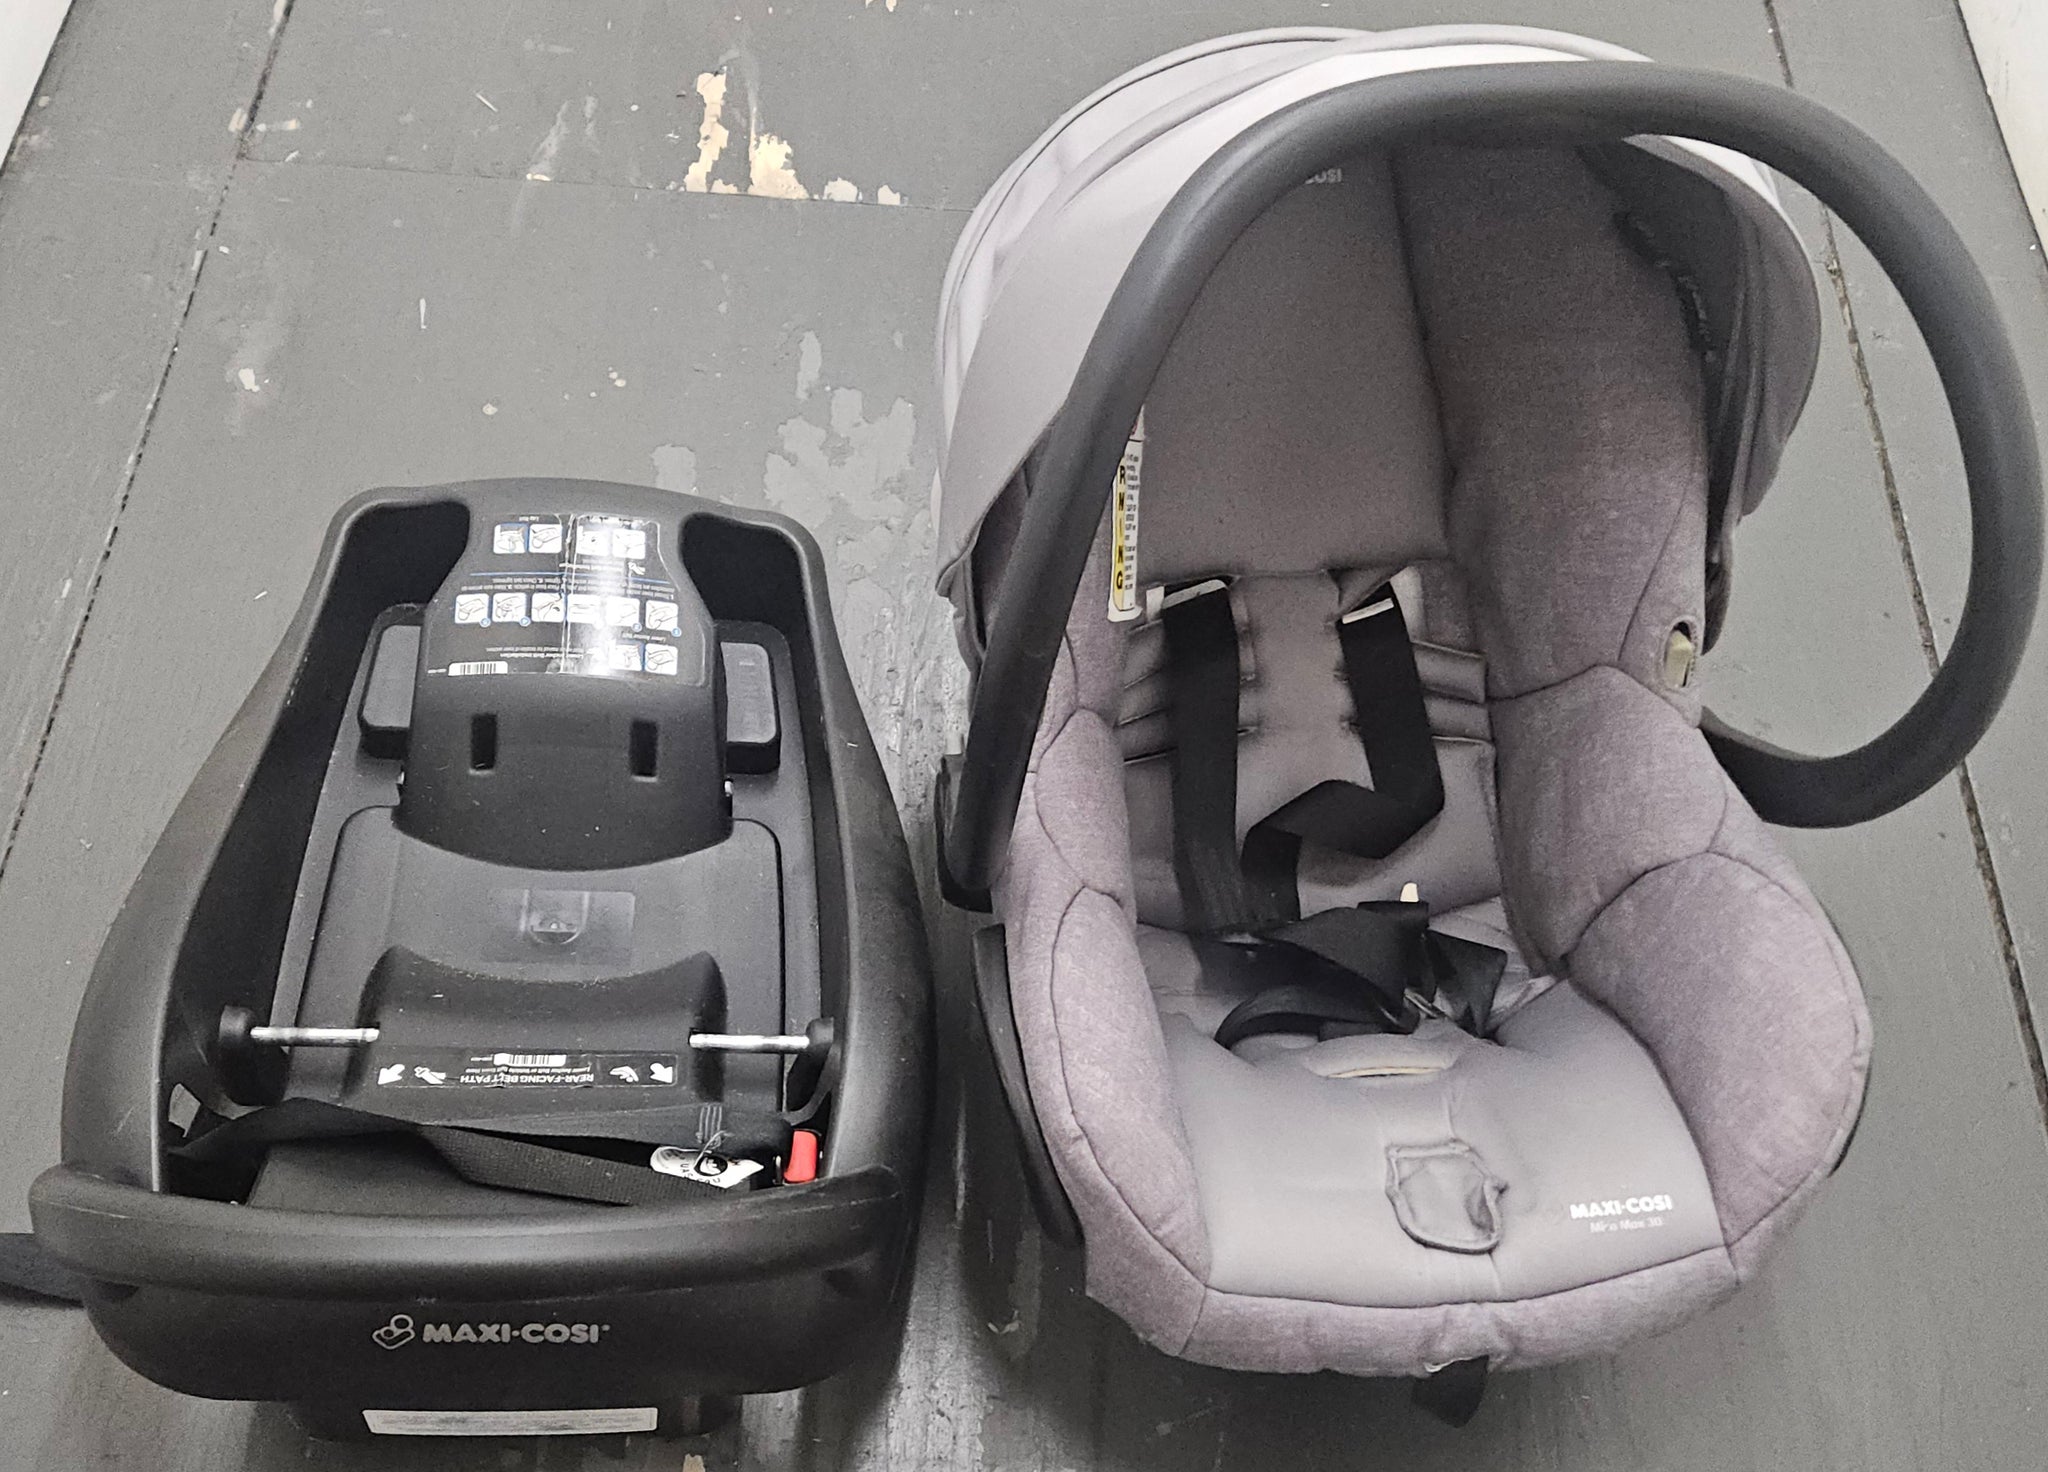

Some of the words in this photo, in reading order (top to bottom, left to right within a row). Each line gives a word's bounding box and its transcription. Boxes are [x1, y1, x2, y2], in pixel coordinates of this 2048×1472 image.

[1116, 465, 1126, 590] RNING
[460, 1074, 490, 1083] PATH
[519, 1073, 594, 1083] REAR-FACING
